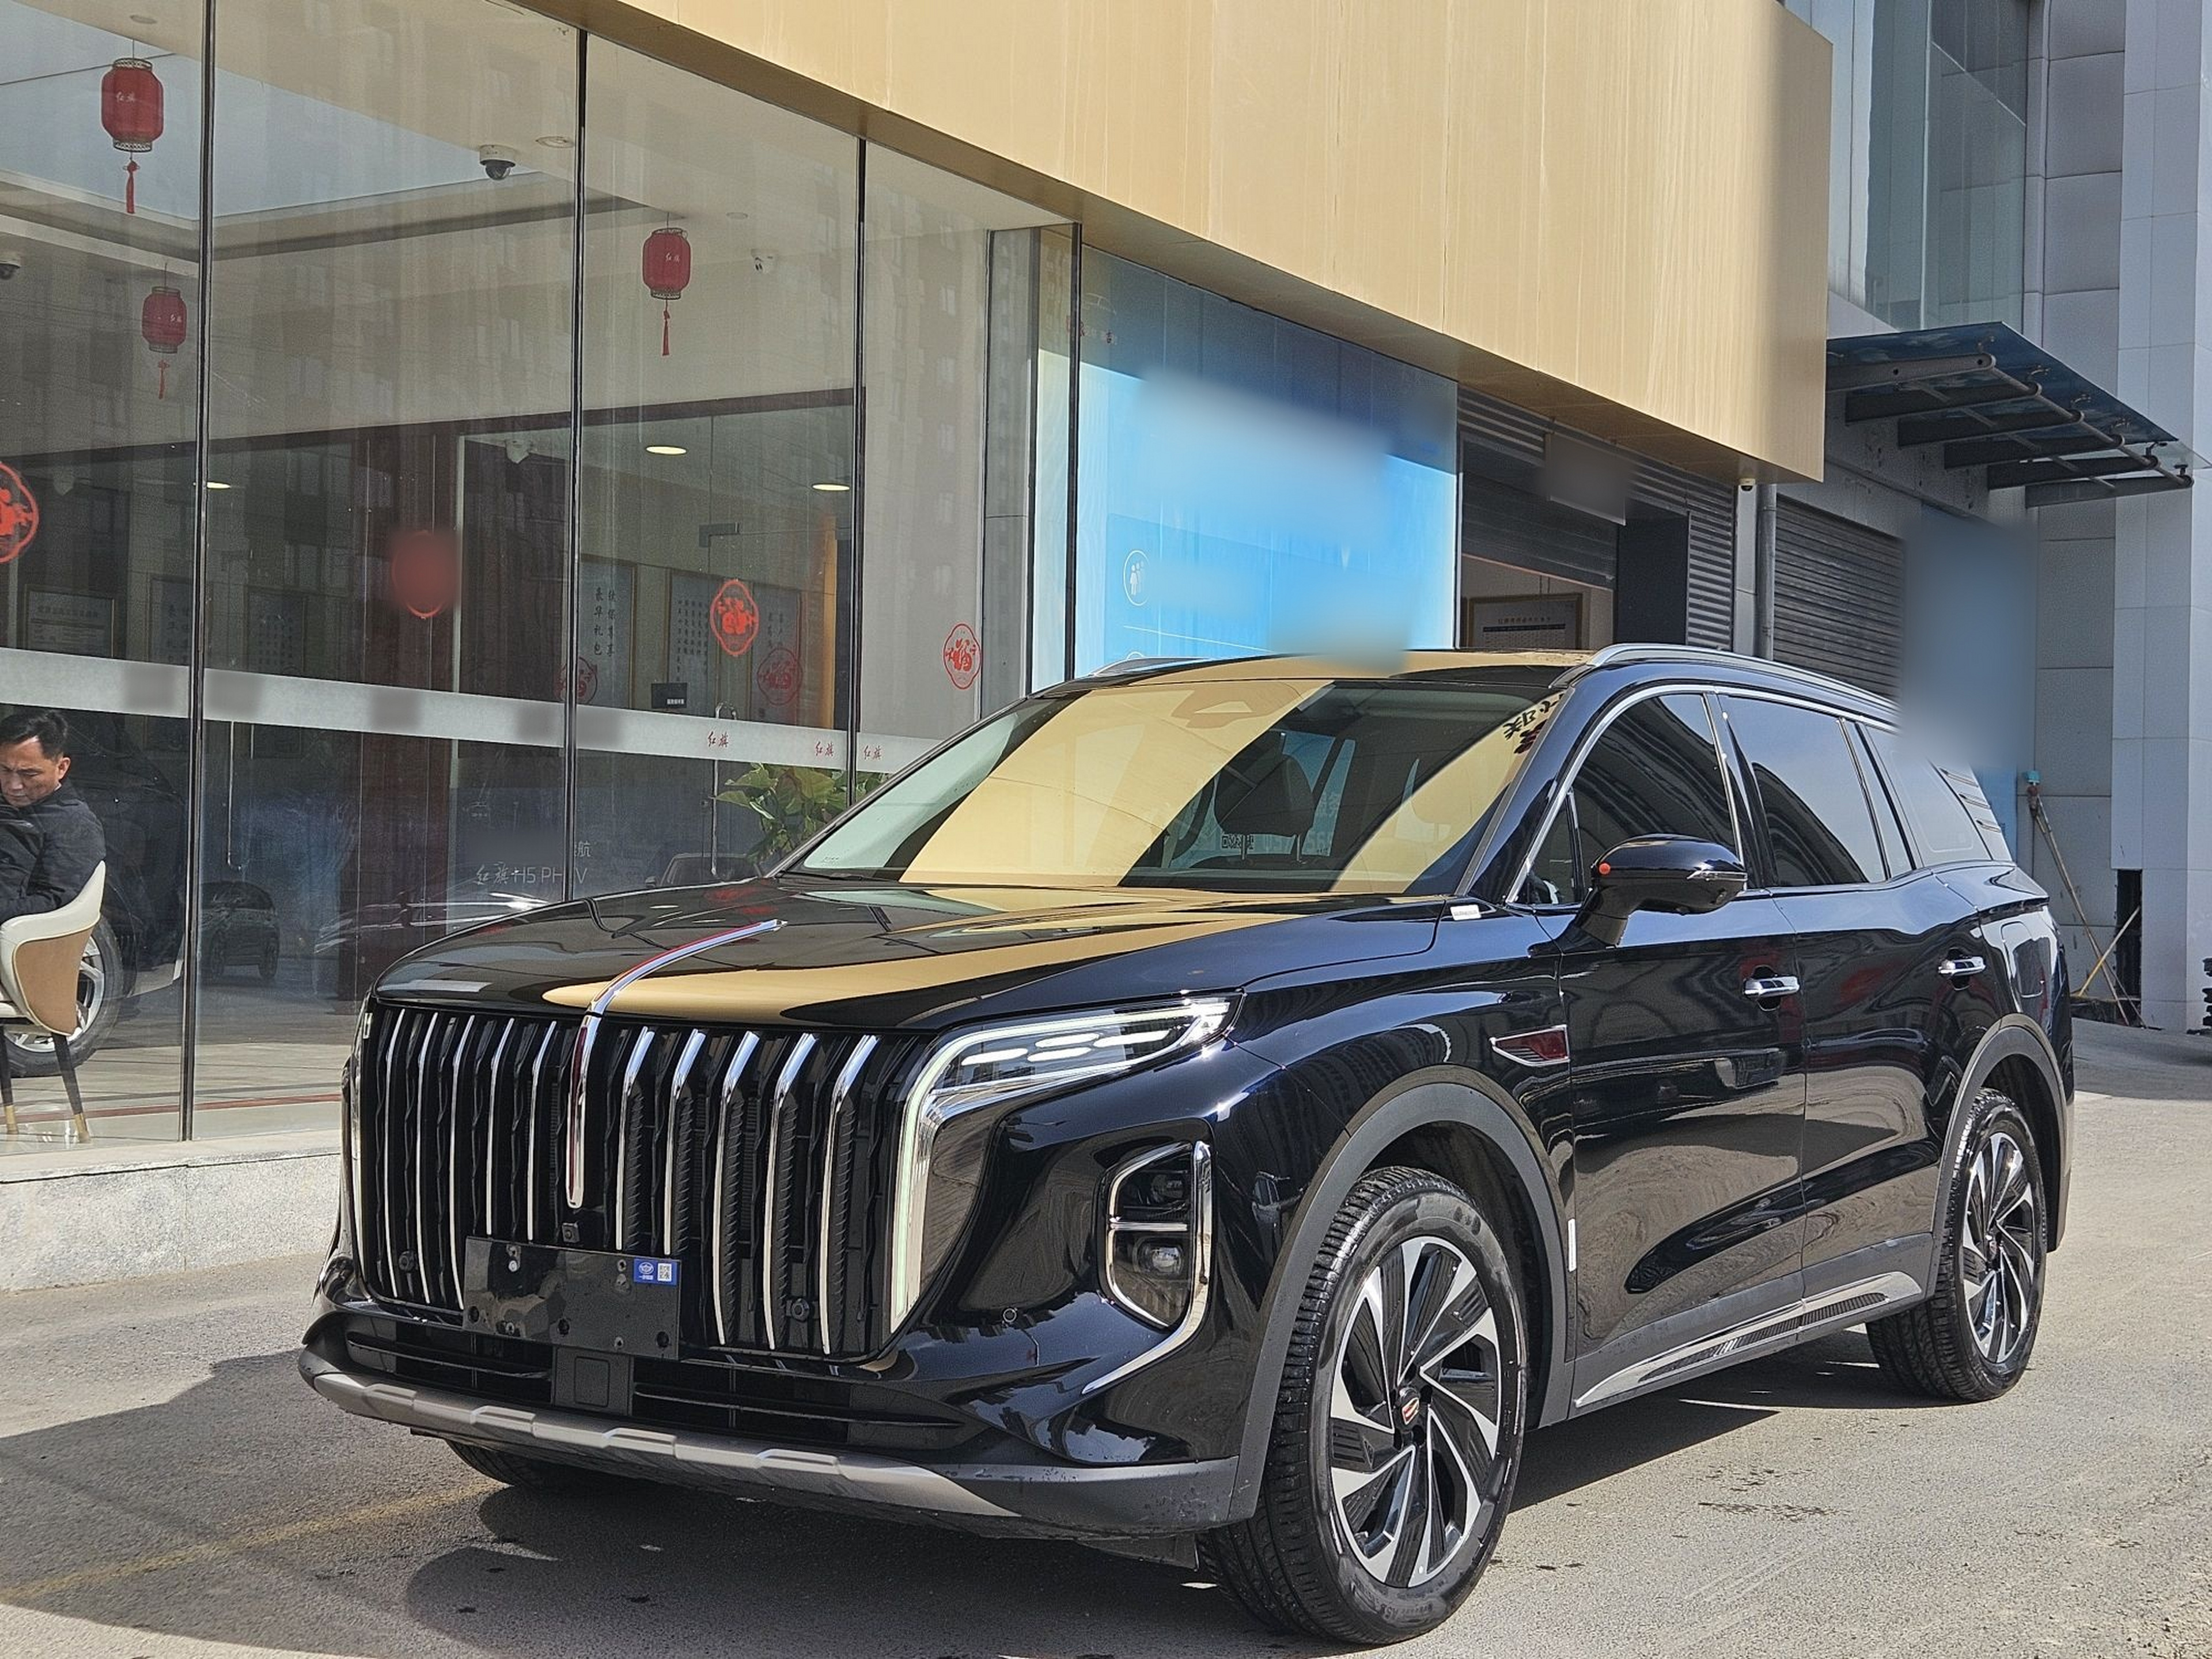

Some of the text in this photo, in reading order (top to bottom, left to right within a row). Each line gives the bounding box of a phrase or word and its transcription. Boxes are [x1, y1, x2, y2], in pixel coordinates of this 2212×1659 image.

[707, 731, 729, 748] 红旗
[815, 741, 834, 757] 红旗
[863, 745, 881, 760] 红旗
[541, 867, 588, 884] PHV
